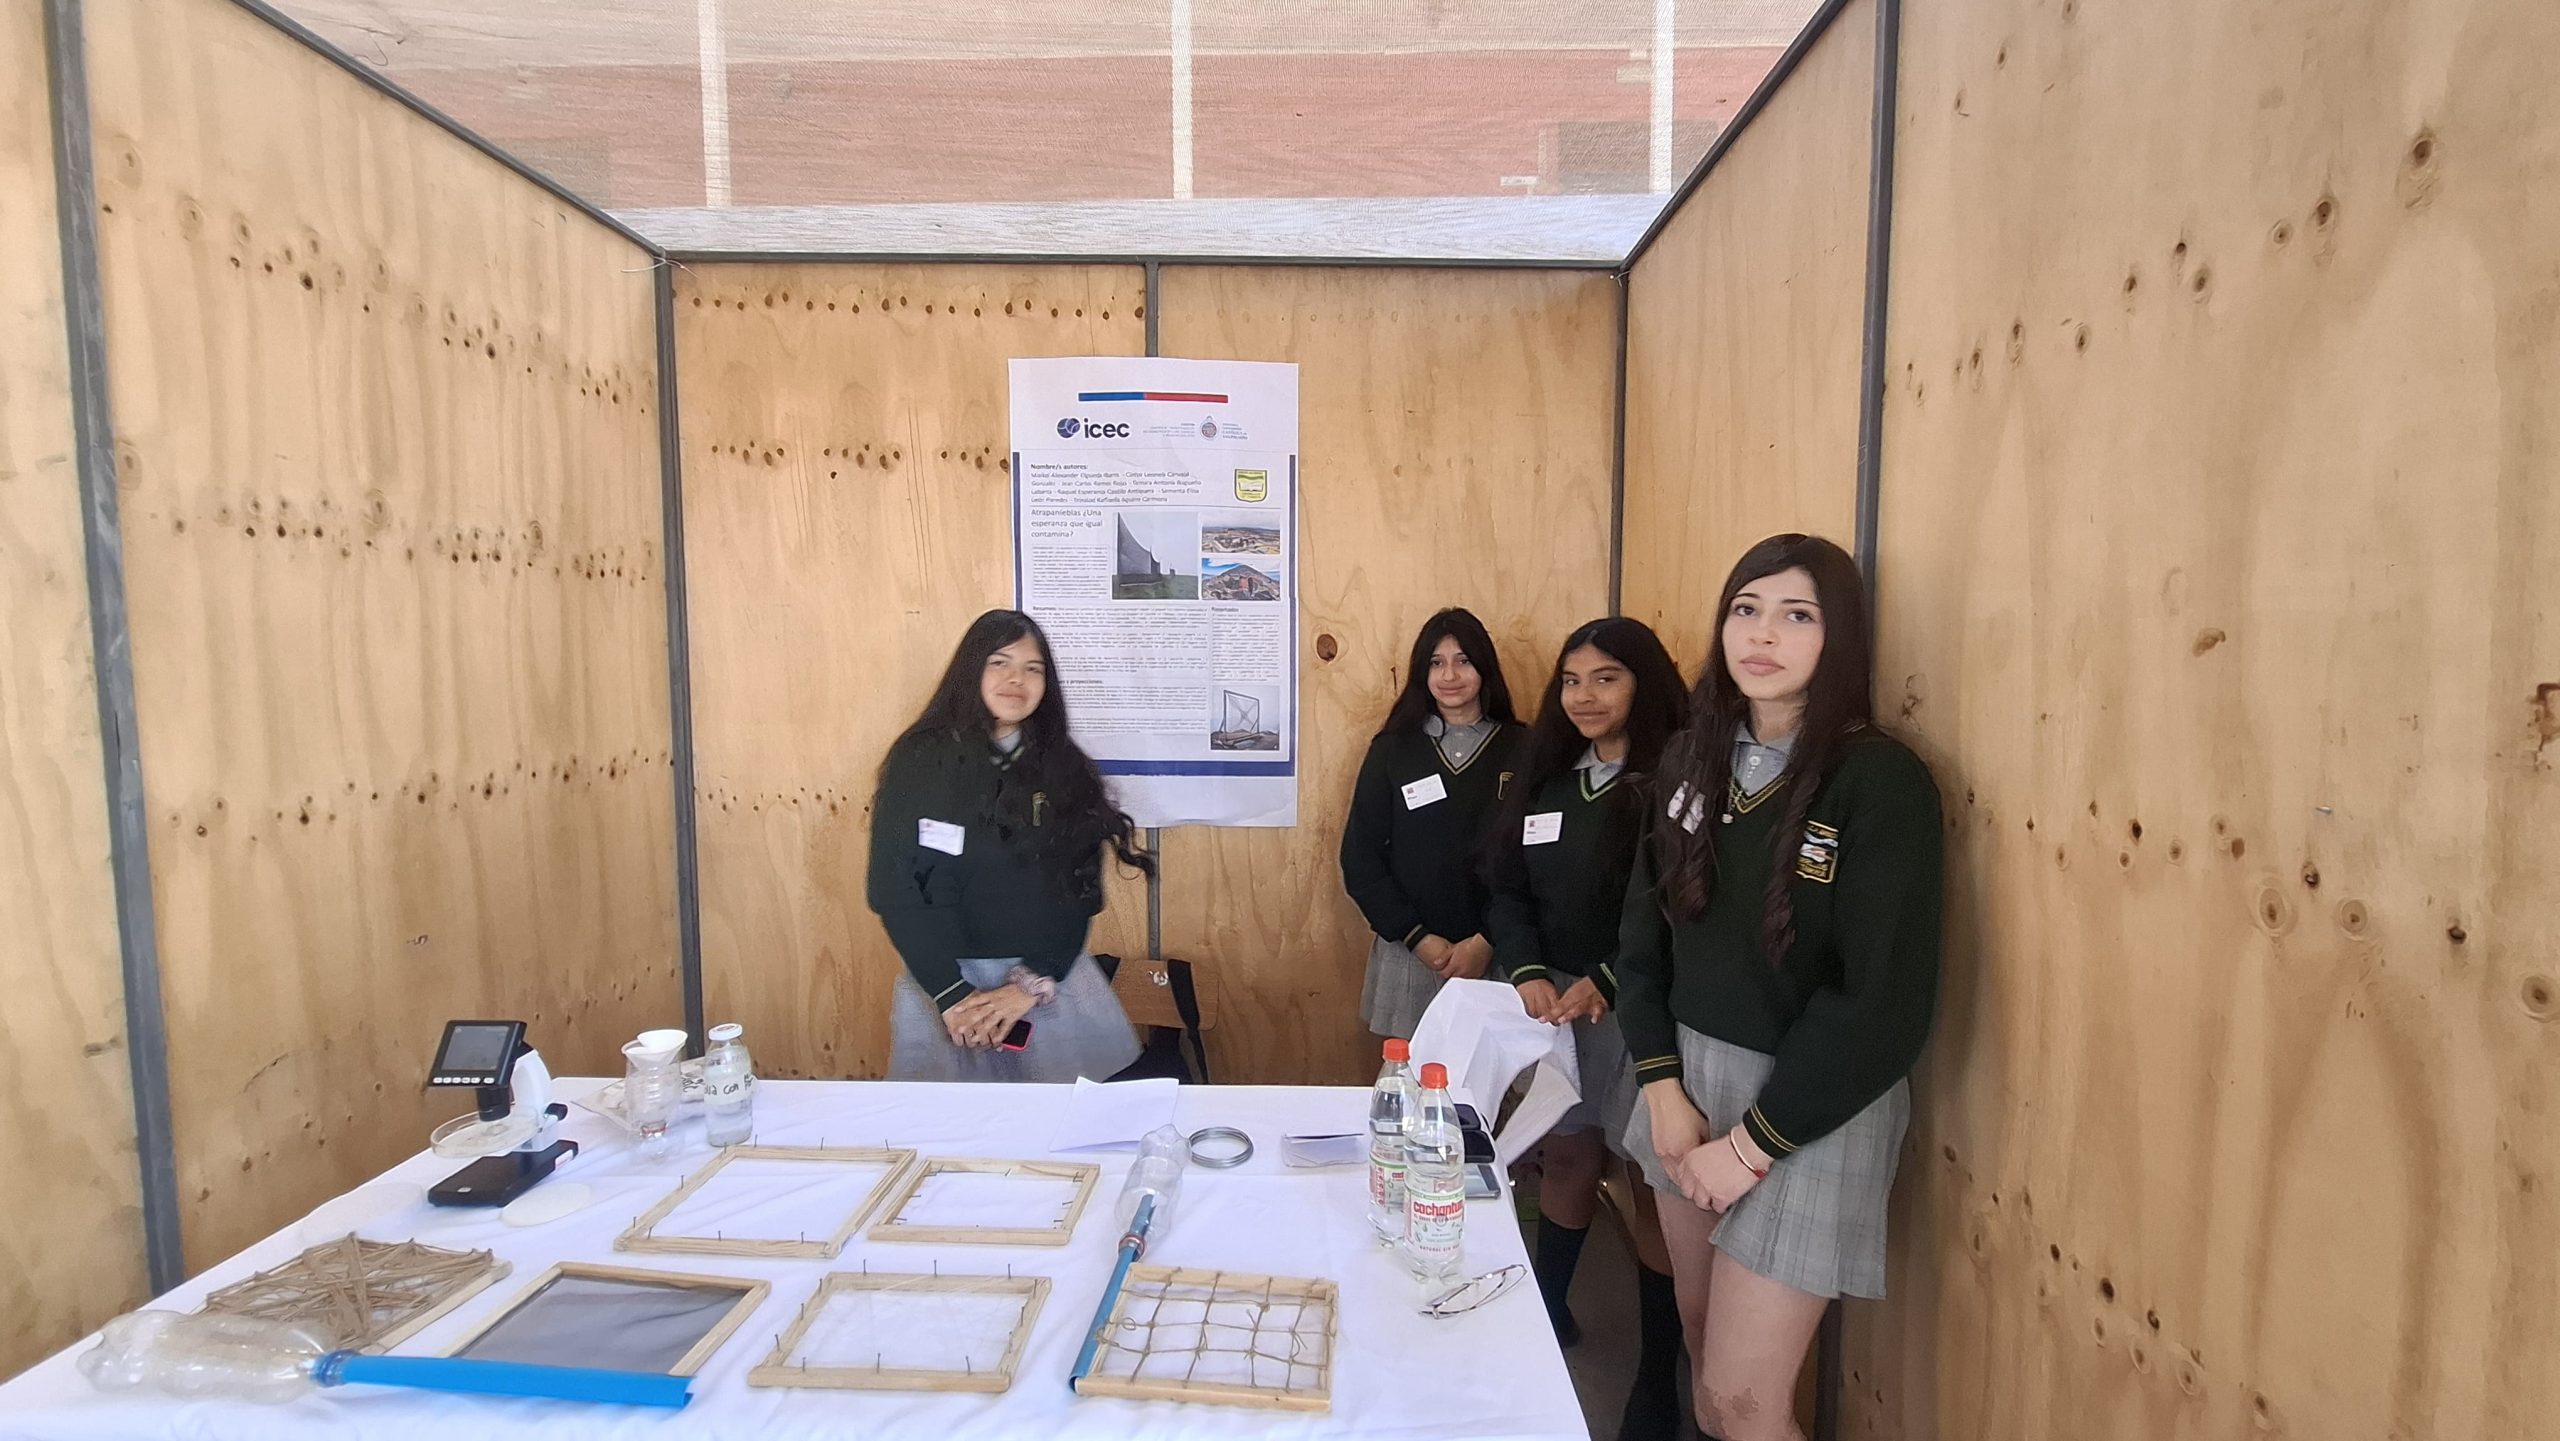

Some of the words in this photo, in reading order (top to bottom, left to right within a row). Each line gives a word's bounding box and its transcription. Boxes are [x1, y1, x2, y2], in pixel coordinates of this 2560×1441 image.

[1084, 418, 1130, 438] icec
[1031, 509, 1081, 517] Atrapanieblas
[1083, 509, 1102, 517] ¿Una
[1031, 520, 1068, 528] esperanza
[1085, 520, 1103, 528] igual
